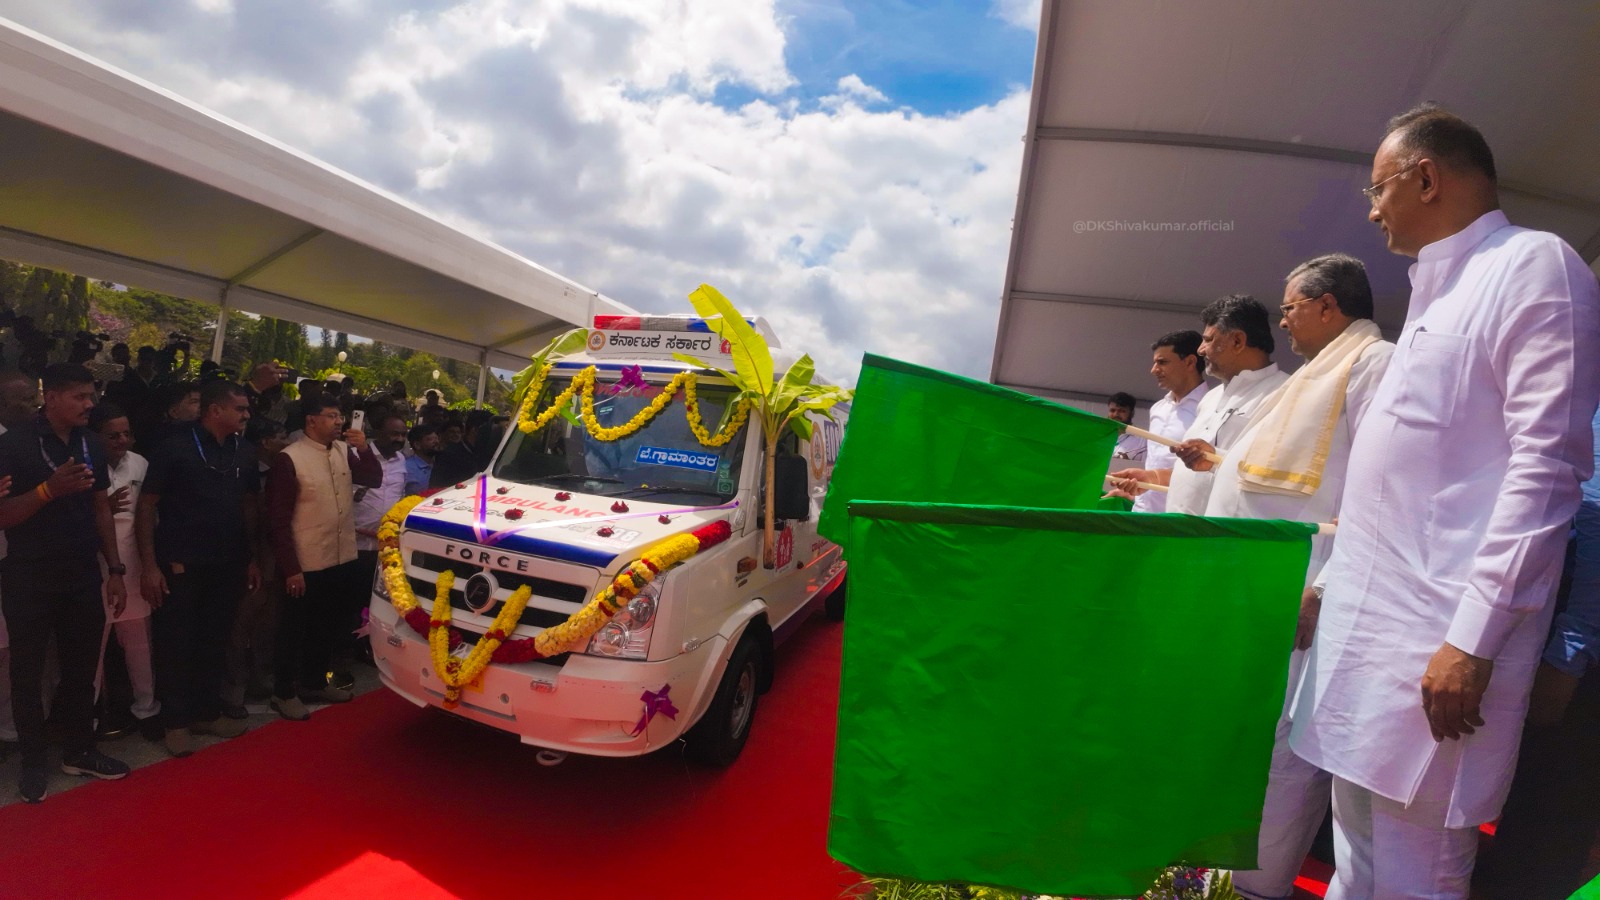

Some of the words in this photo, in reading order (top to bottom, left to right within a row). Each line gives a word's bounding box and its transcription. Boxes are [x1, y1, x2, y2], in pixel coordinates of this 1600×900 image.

[609, 332, 661, 348] ಕರ್ನಾಟಕ
[665, 333, 712, 351] ಸರ್ಕಾರ
[640, 448, 717, 467] ಬೆ.ಗ್ರಾಮಾಂತರ
[466, 495, 616, 523] MBULANC
[445, 544, 529, 572] FORCE
